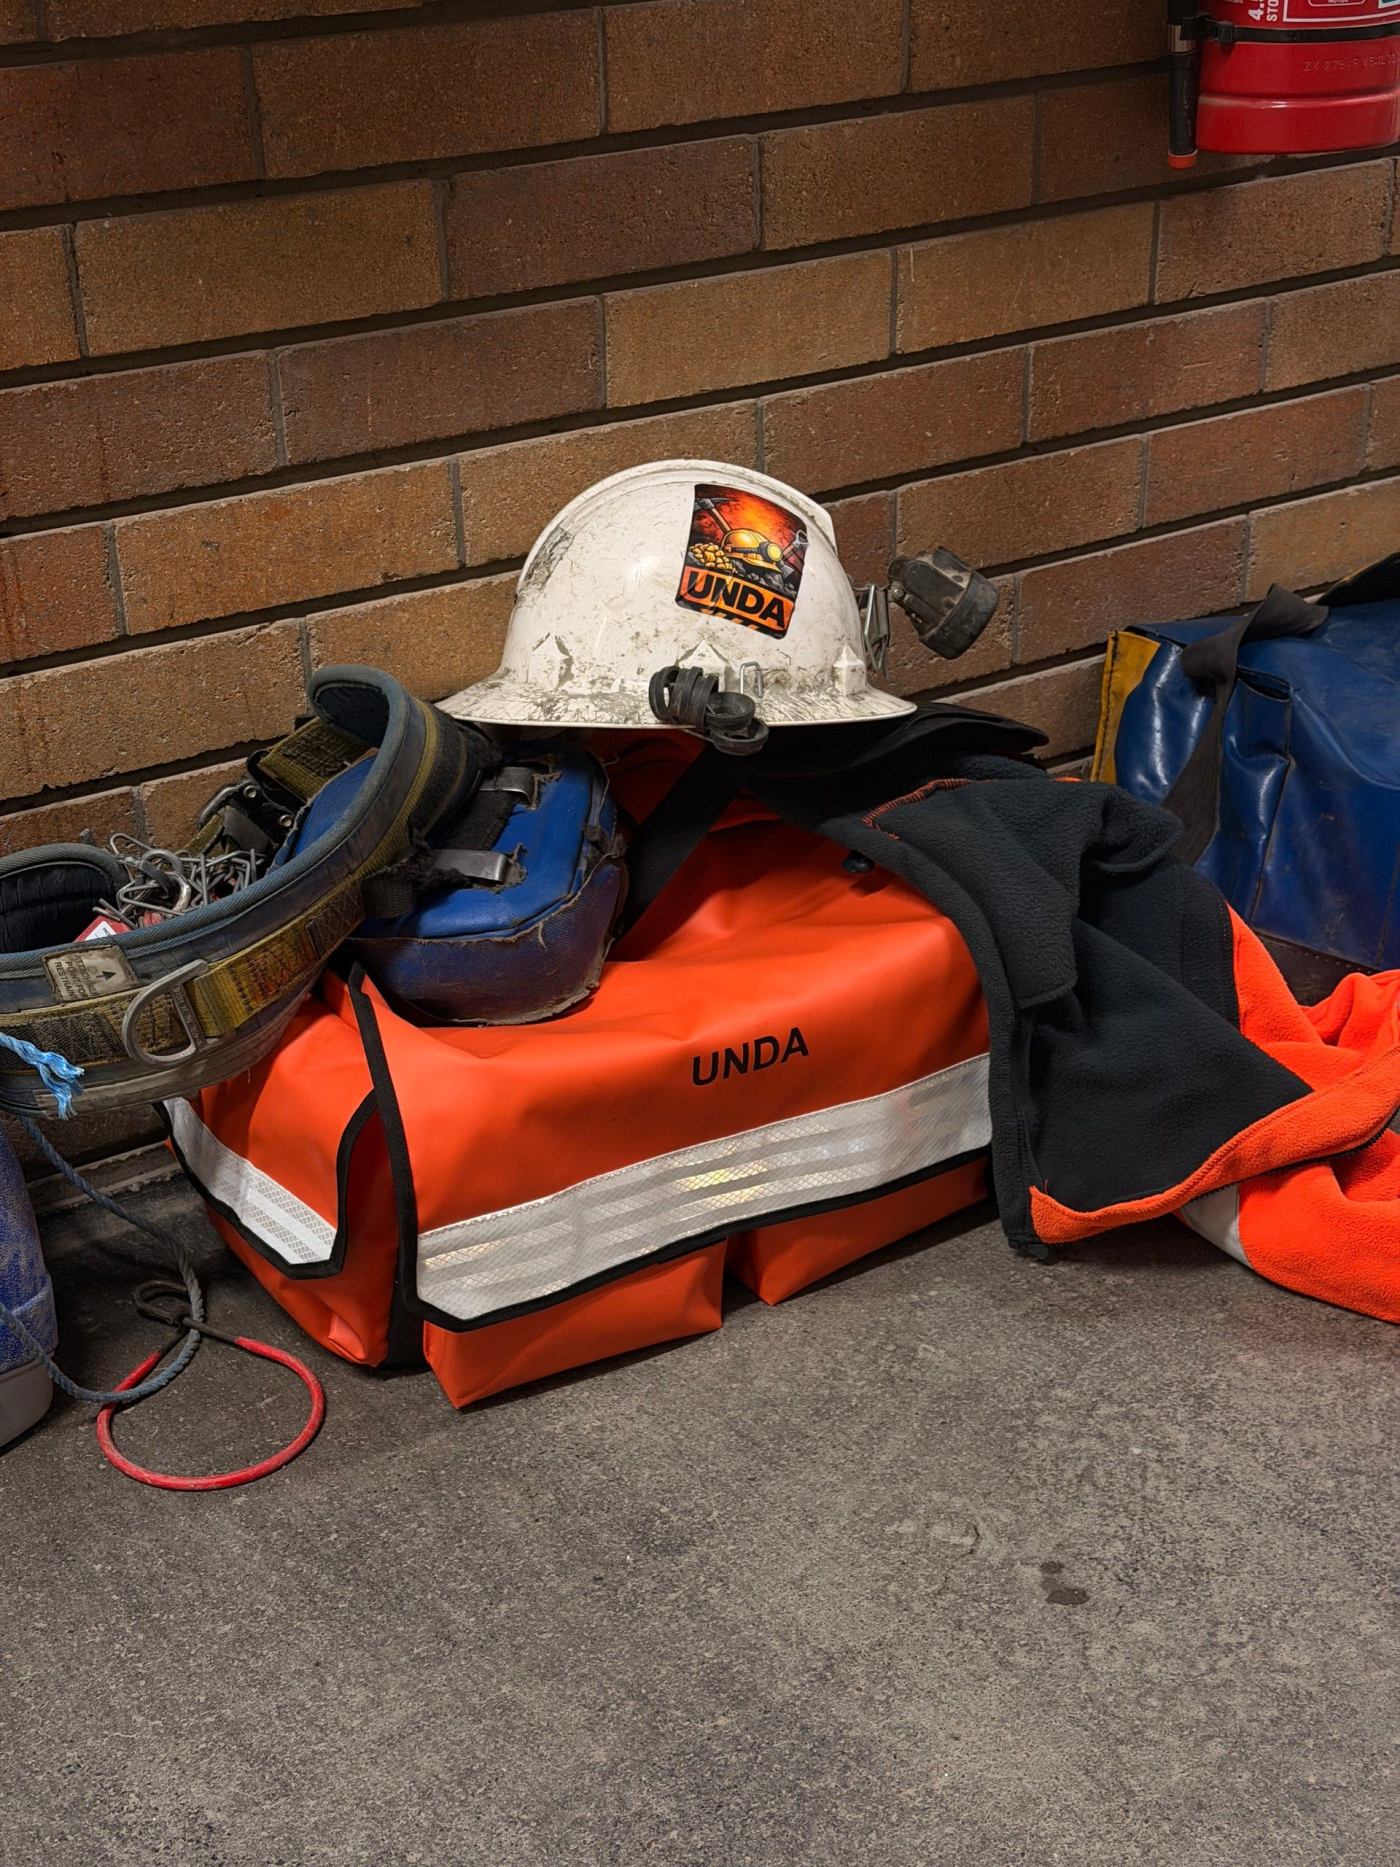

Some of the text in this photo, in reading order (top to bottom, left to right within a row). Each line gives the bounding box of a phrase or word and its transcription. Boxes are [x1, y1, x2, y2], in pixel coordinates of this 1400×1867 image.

[687, 571, 785, 628] UNDA
[55, 961, 78, 999] RESTRAINT
[692, 1027, 809, 1086] UNDA
